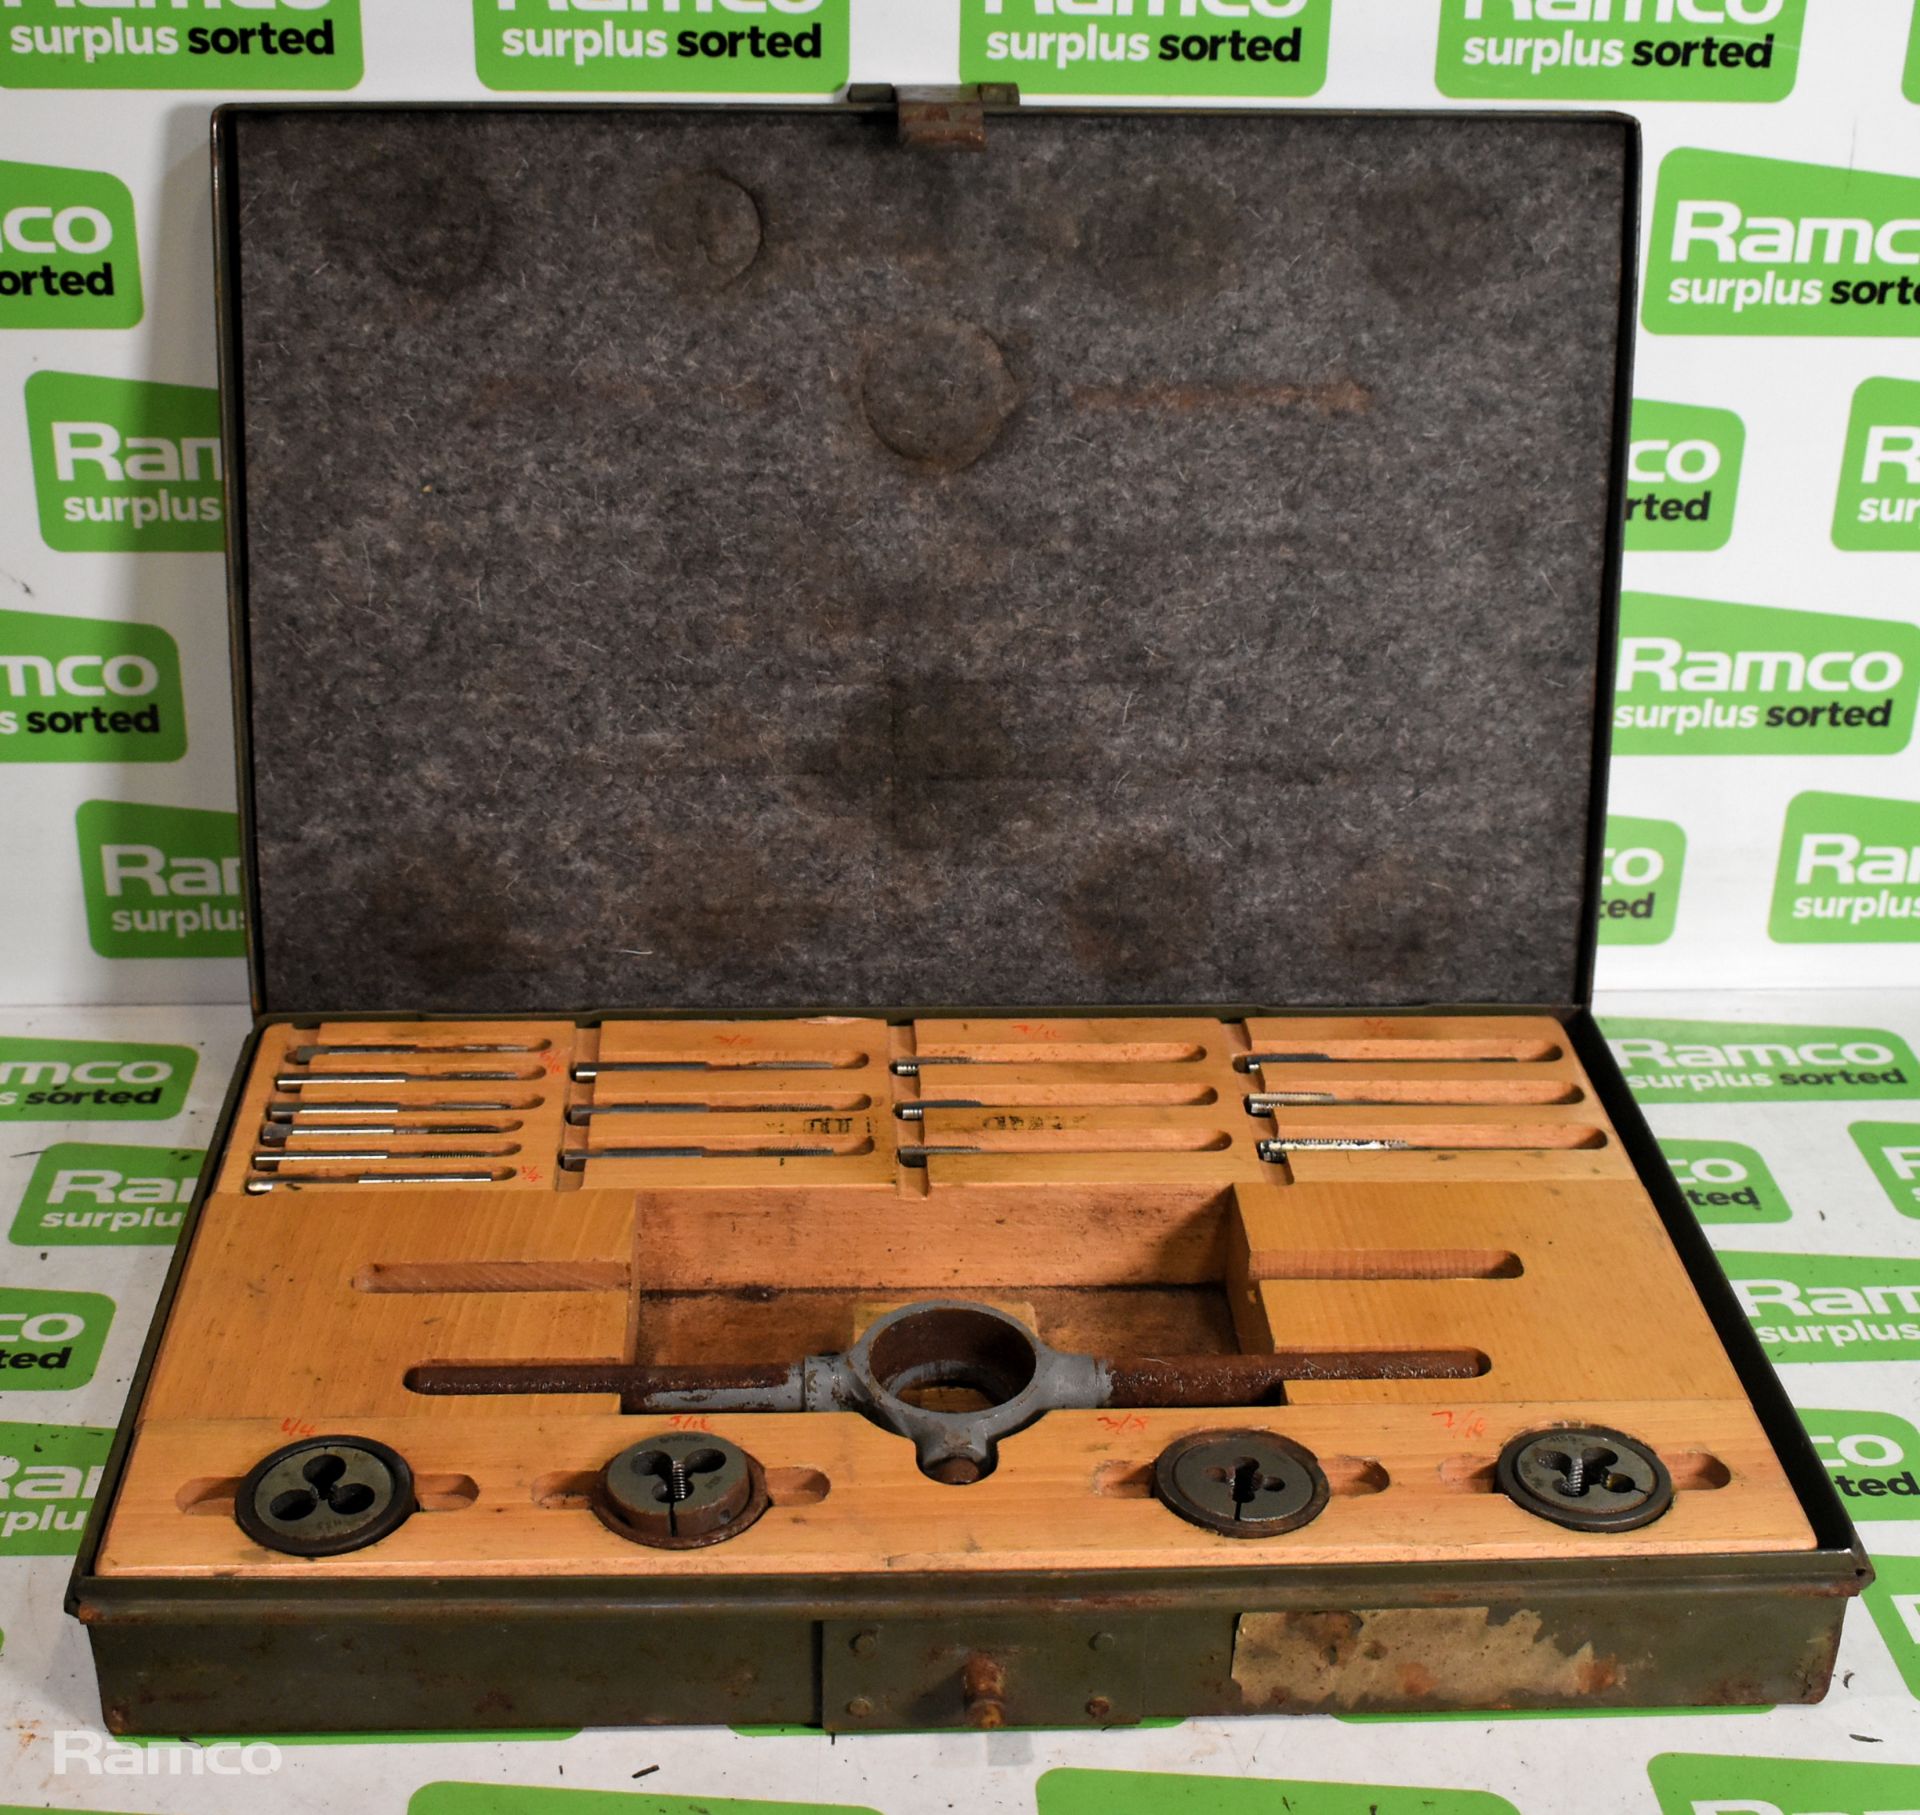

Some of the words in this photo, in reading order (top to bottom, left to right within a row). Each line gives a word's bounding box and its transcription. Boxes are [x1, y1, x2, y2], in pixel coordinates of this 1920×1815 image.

[10, 17, 179, 63] surplus
[188, 19, 335, 55] sorted
[502, 20, 668, 66] surplus
[677, 23, 821, 58] sorted
[986, 24, 1150, 69] surplus
[1157, 27, 1302, 62] sorted
[1462, 29, 1625, 75] surplus
[1631, 33, 1774, 68] sorted
[0, 206, 113, 254] co
[1670, 200, 1920, 264] Ramc
[0, 262, 114, 296] orted
[1668, 271, 1823, 312] surplus
[63, 489, 222, 528] surplus
[1625, 490, 1711, 521] rted
[1857, 497, 1920, 526] sur
[0, 655, 159, 697] mco
[1615, 637, 1903, 693] Ramco
[27, 704, 160, 734] sorted
[1614, 698, 1758, 735] surplus
[1765, 699, 1893, 728] sorted
[1796, 833, 1920, 884] Ra
[1607, 1038, 1894, 1067] Ramco
[0, 1061, 173, 1084] mco
[1627, 1070, 1773, 1091] surplus
[1779, 1068, 1908, 1085] sorted
[25, 1087, 163, 1105] sorted
[46, 1169, 198, 1204] Ra
[1685, 1186, 1761, 1207] ted
[40, 1207, 185, 1232] surplu
[1834, 1471, 1920, 1497] ted
[0, 1504, 87, 1537] plu
